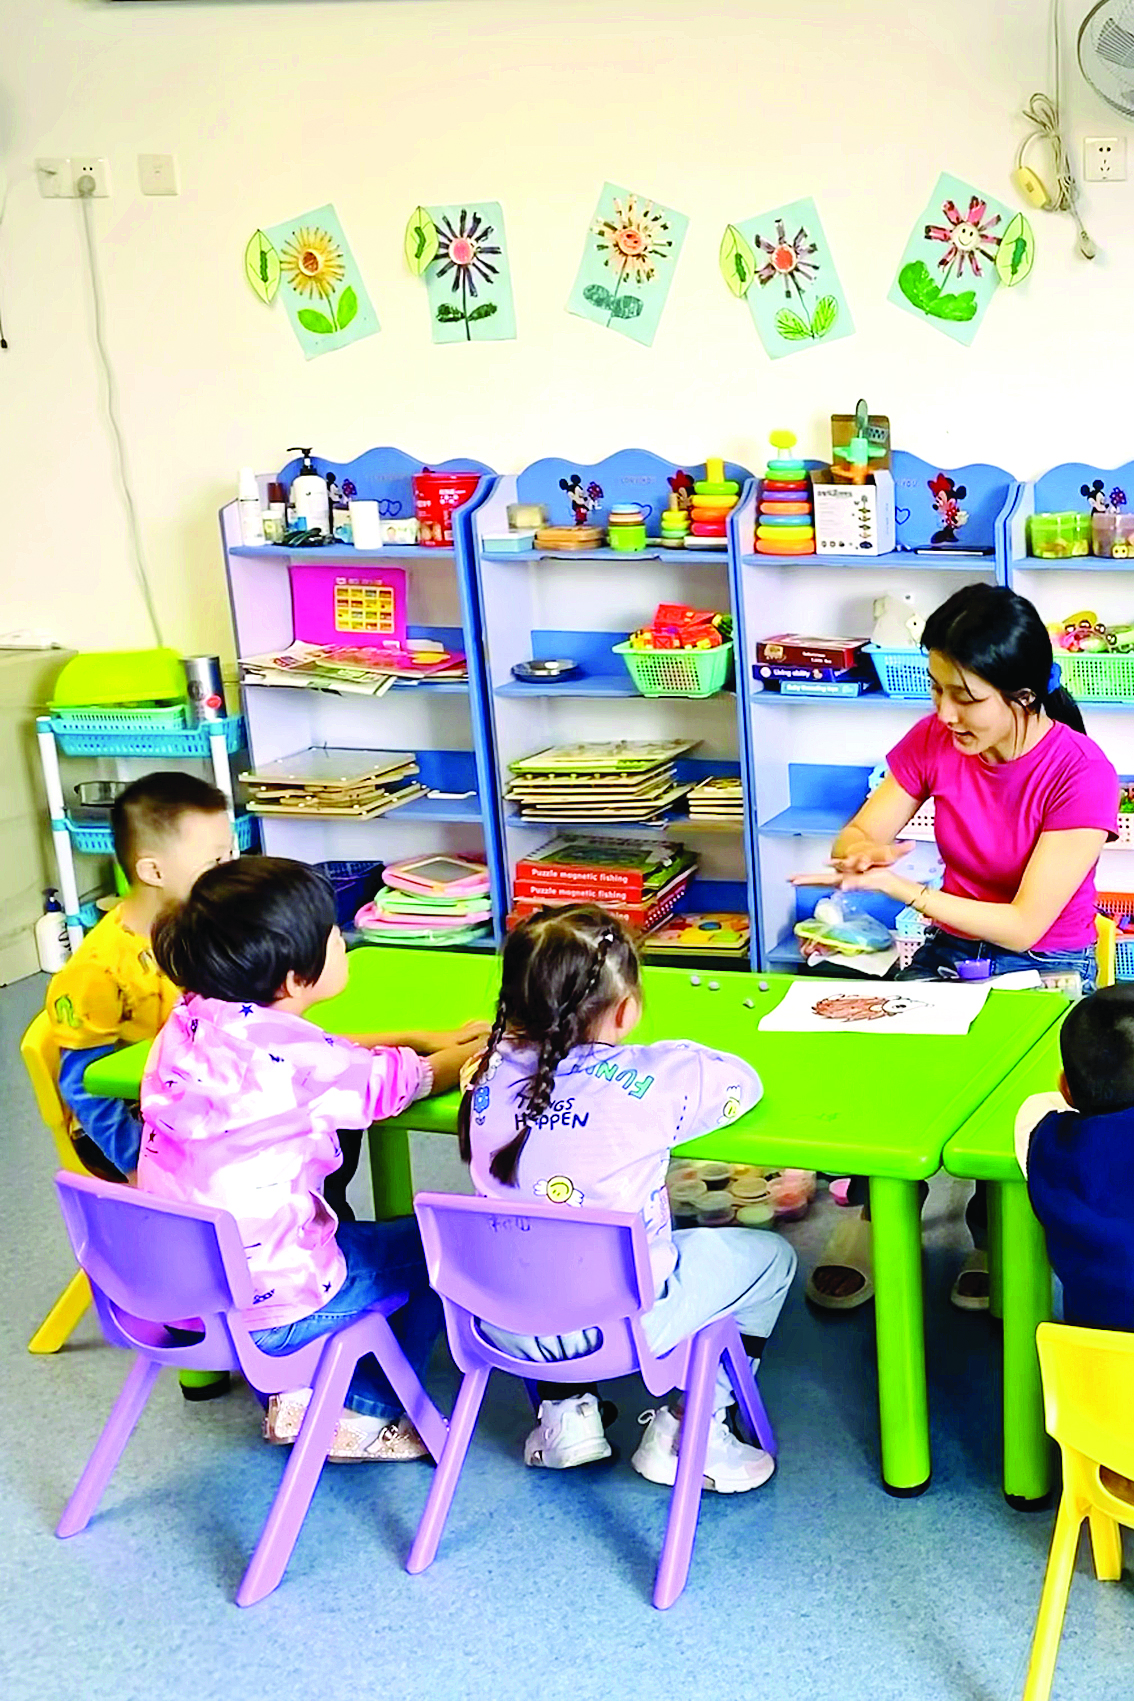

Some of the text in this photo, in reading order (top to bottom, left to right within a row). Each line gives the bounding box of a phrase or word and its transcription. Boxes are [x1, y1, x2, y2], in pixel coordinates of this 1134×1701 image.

[531, 868, 629, 884] Puzzle magnetic fishing
[530, 886, 627, 900] Puzzle magnetic fishing
[514, 1111, 590, 1131] HPPEN
